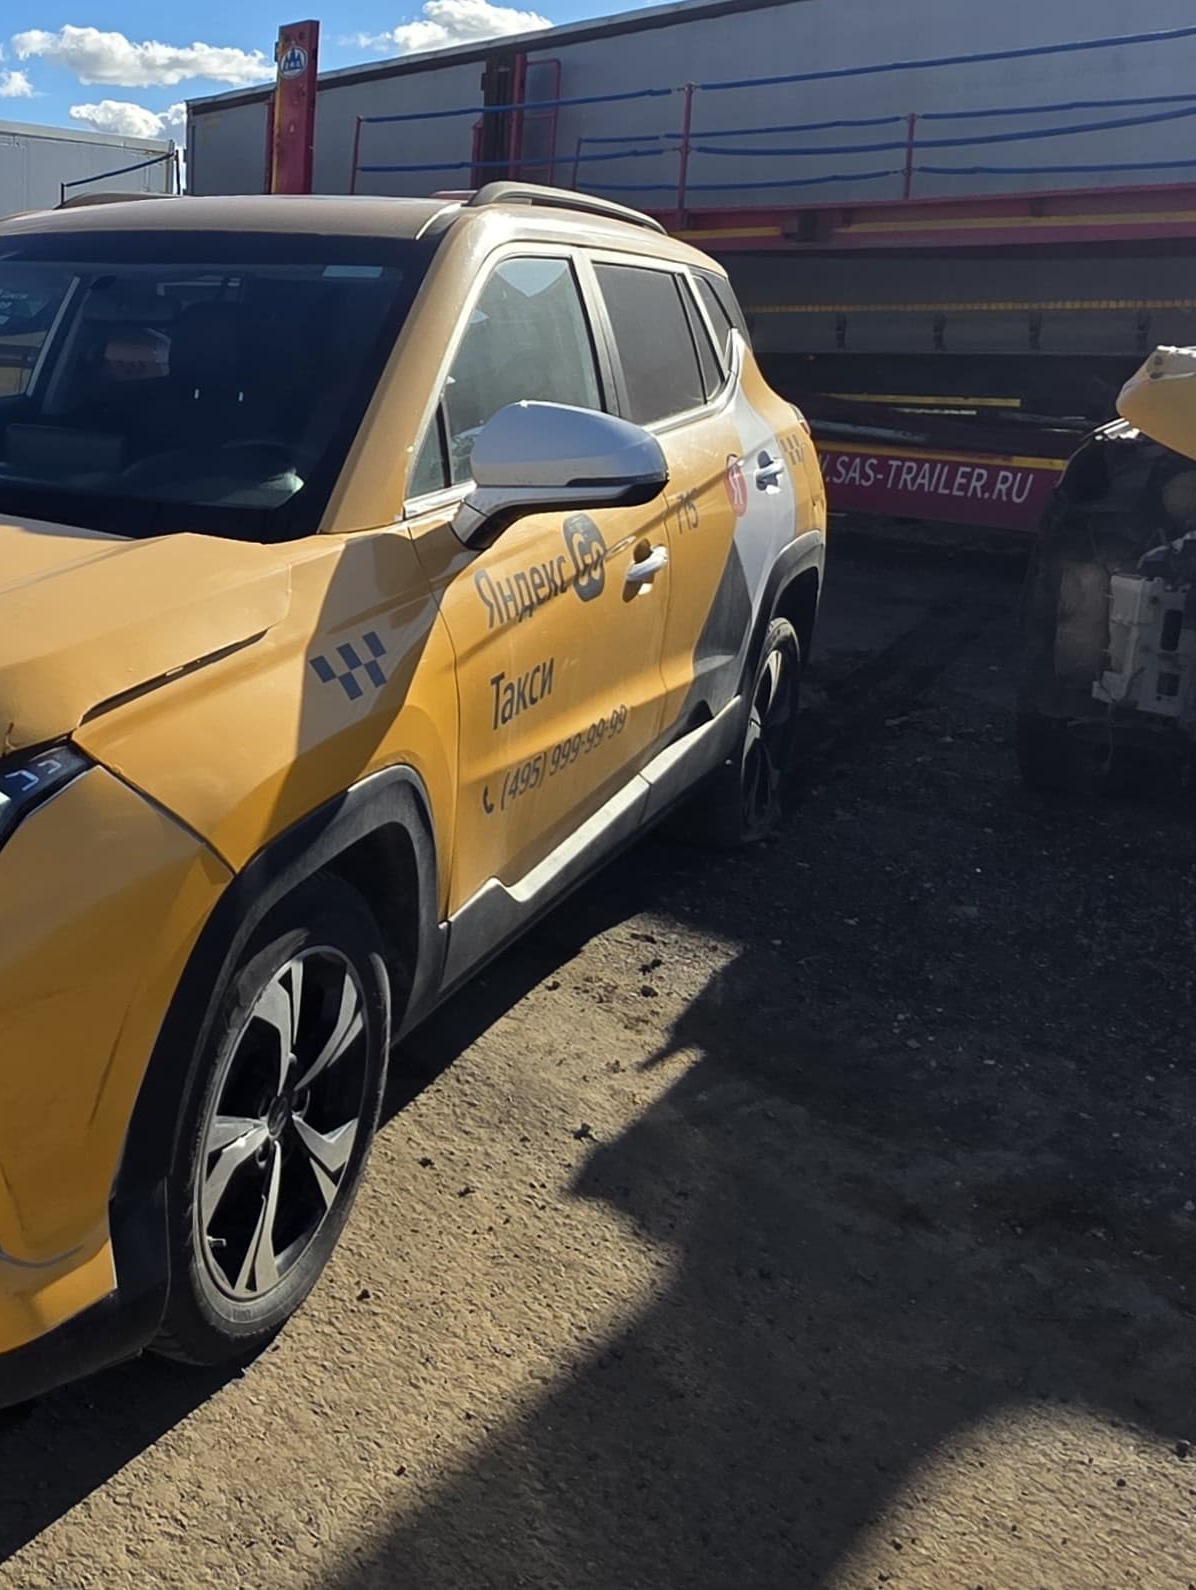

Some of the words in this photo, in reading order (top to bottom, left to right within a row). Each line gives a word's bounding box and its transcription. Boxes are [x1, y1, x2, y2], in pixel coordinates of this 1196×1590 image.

[676, 488, 699, 535] 715
[474, 555, 567, 629] Яндекс
[490, 657, 554, 731] Такси
[500, 752, 547, 811] (495)
[549, 704, 628, 777] 999-99-99
